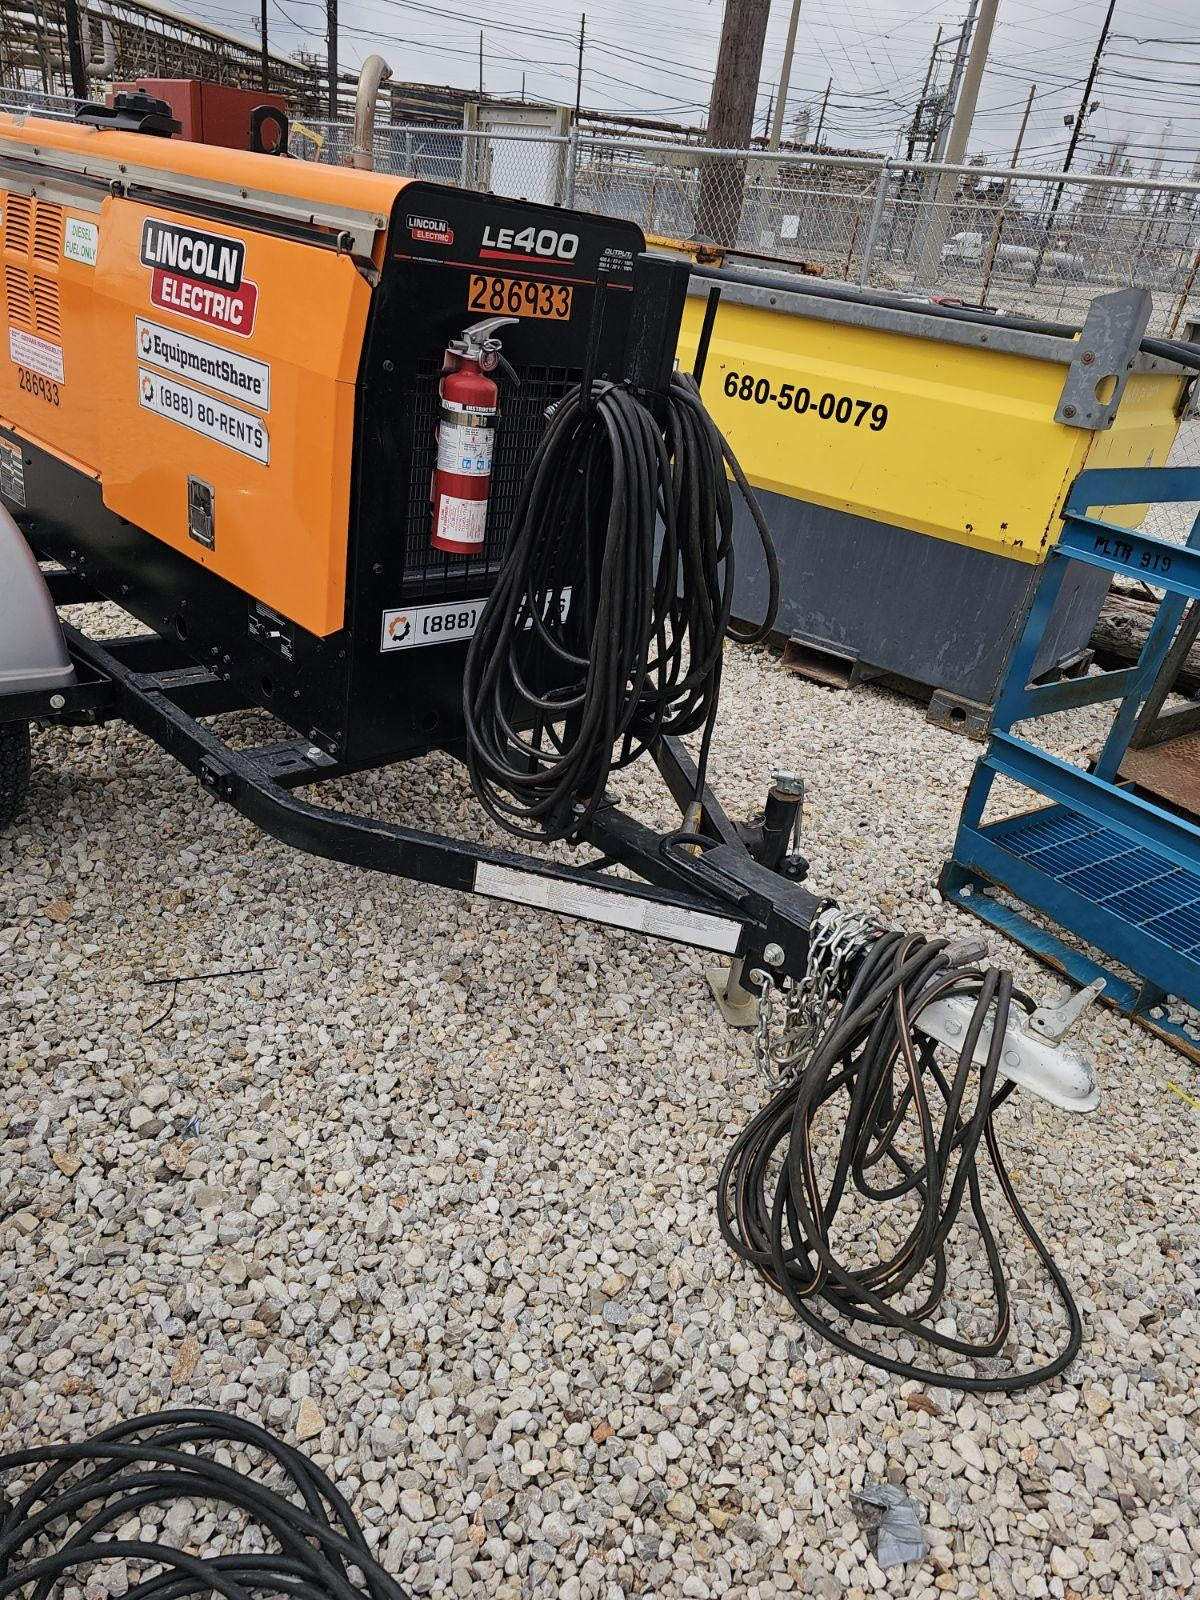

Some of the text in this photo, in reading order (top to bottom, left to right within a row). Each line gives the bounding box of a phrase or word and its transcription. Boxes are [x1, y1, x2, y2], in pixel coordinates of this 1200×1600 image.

[72, 225, 91, 241] DIESEL
[408, 217, 446, 232] LINCOLN
[416, 230, 449, 242] ELECTRIC
[481, 226, 579, 259] LE400
[66, 242, 96, 261] FUEL ONLY
[145, 227, 238, 285] LINCOLN
[161, 276, 244, 326] ELECTRIC
[470, 276, 570, 317] 286933
[154, 335, 261, 395] EquipmentShare
[18, 367, 60, 406] 286933
[724, 372, 888, 431] 680-50-0079
[160, 386, 263, 448] (888) 80-RENTS
[1140, 552, 1172, 572] 919
[423, 610, 477, 635] (888)
